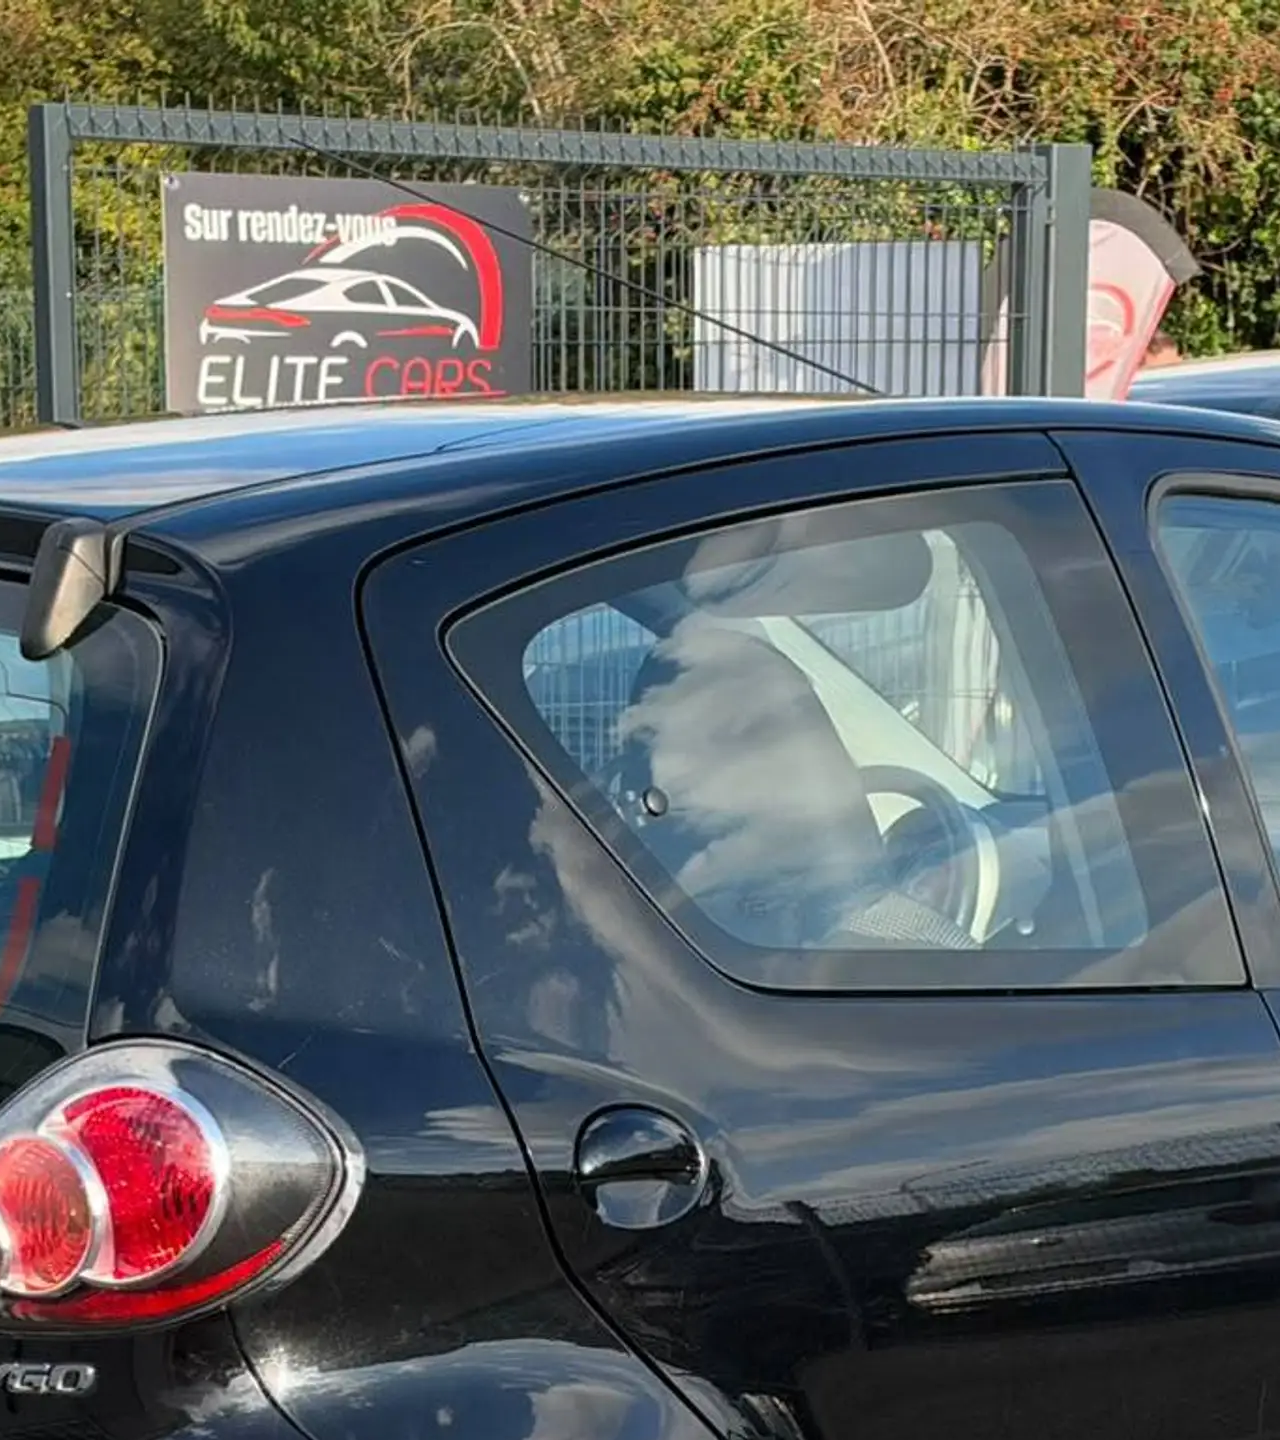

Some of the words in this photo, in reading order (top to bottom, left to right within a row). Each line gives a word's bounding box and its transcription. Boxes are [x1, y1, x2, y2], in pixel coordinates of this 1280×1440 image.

[183, 203, 236, 242] Sur
[237, 205, 399, 247] rendez-vous
[197, 354, 350, 405] ELITE
[364, 356, 493, 398] CARS
